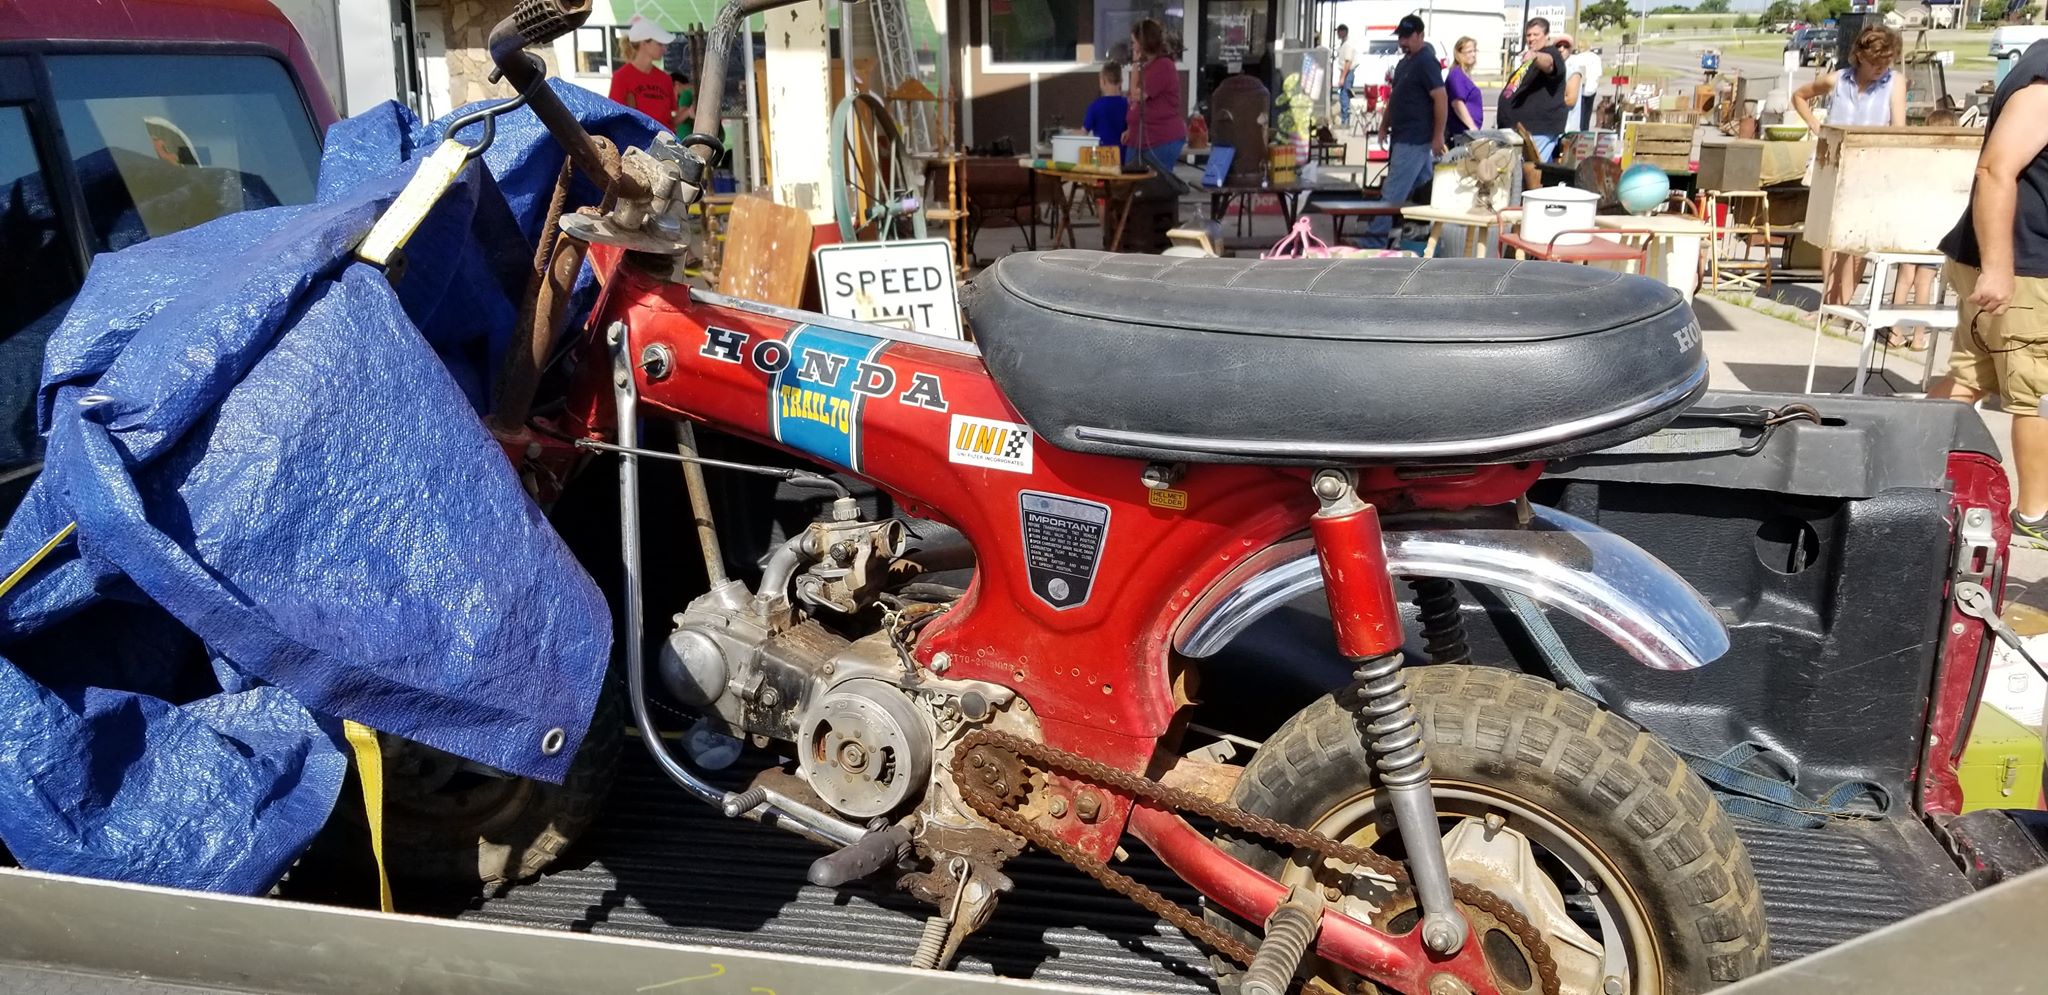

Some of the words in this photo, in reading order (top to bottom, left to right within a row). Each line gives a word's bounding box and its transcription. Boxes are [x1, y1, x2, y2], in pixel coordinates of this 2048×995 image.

[836, 266, 942, 297] SPEED
[700, 325, 949, 413] HONDA
[1153, 491, 1183, 499] HELMET
[1153, 497, 1182, 505] HOLDER
[1029, 514, 1097, 533] IMPORTANT
